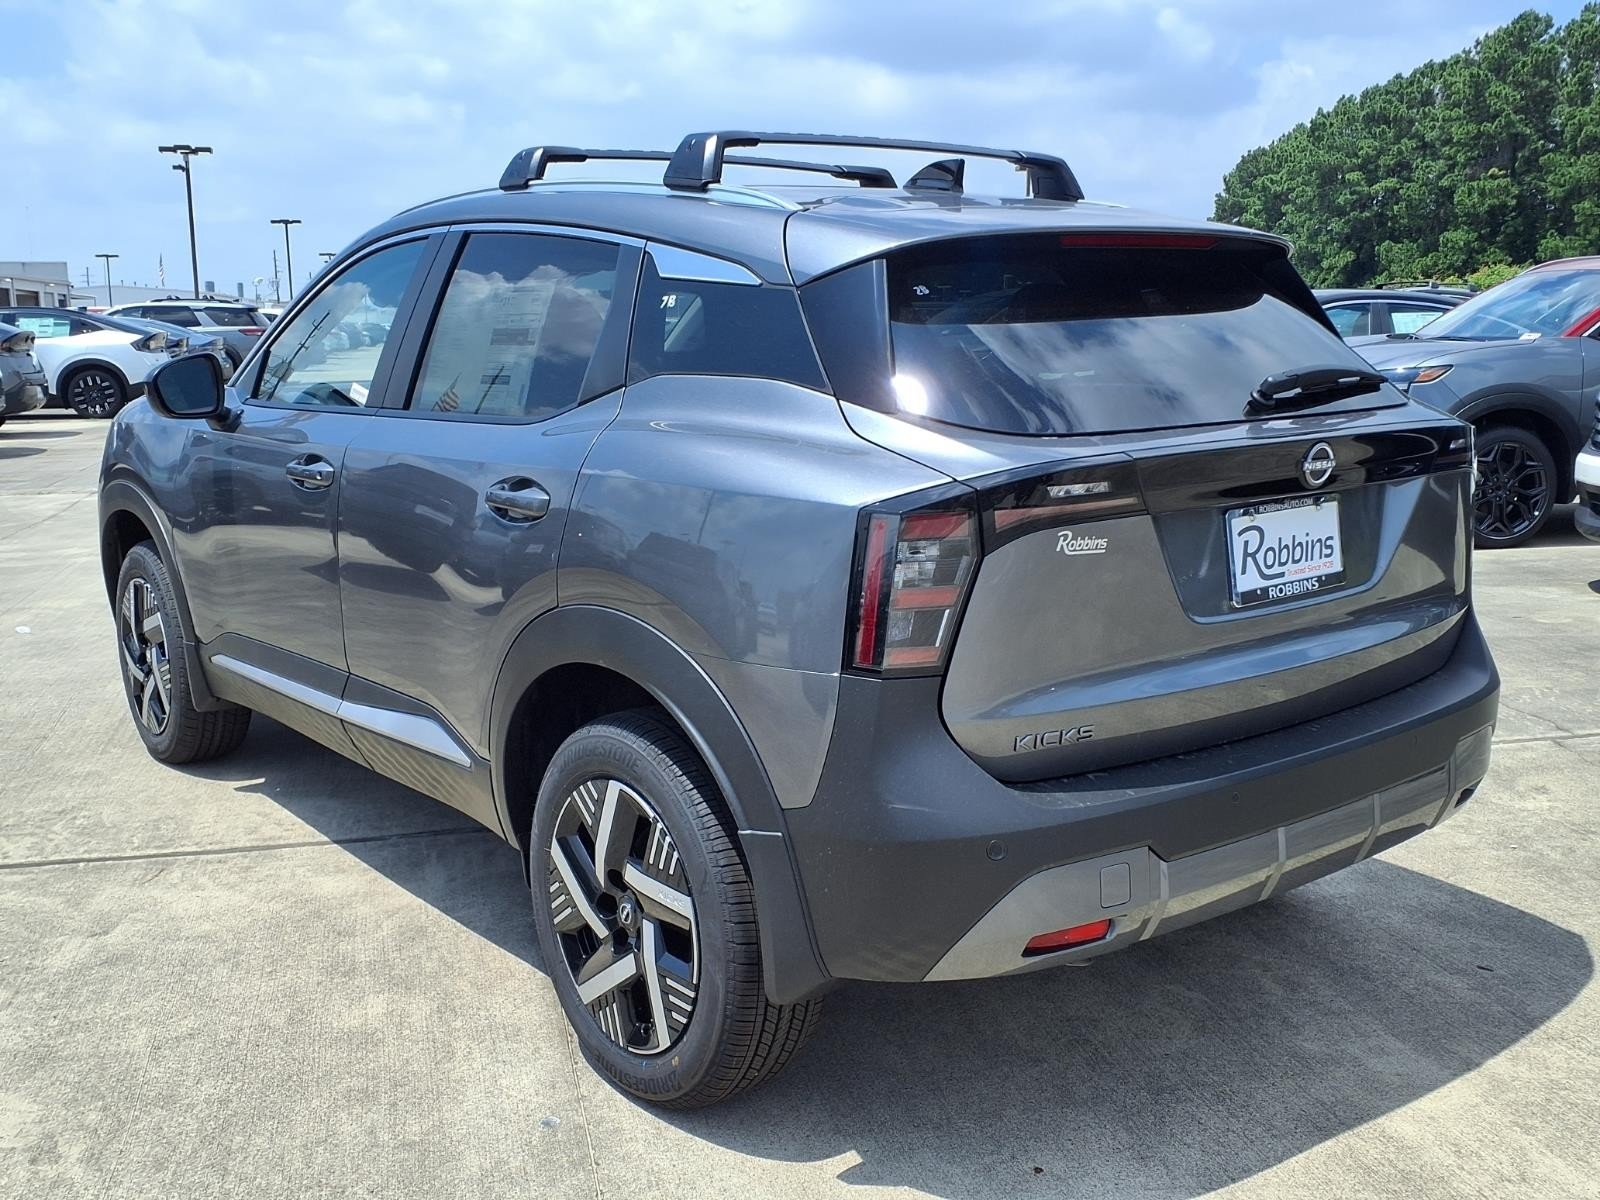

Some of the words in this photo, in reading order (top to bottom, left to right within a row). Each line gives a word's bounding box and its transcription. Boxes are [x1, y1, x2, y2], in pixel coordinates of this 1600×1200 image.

[1303, 460, 1336, 471] NISSAN
[1056, 530, 1108, 555] Robbins
[1237, 525, 1335, 581] Robbins
[1268, 577, 1320, 599] ROBBINS
[1013, 724, 1096, 752] KICKS
